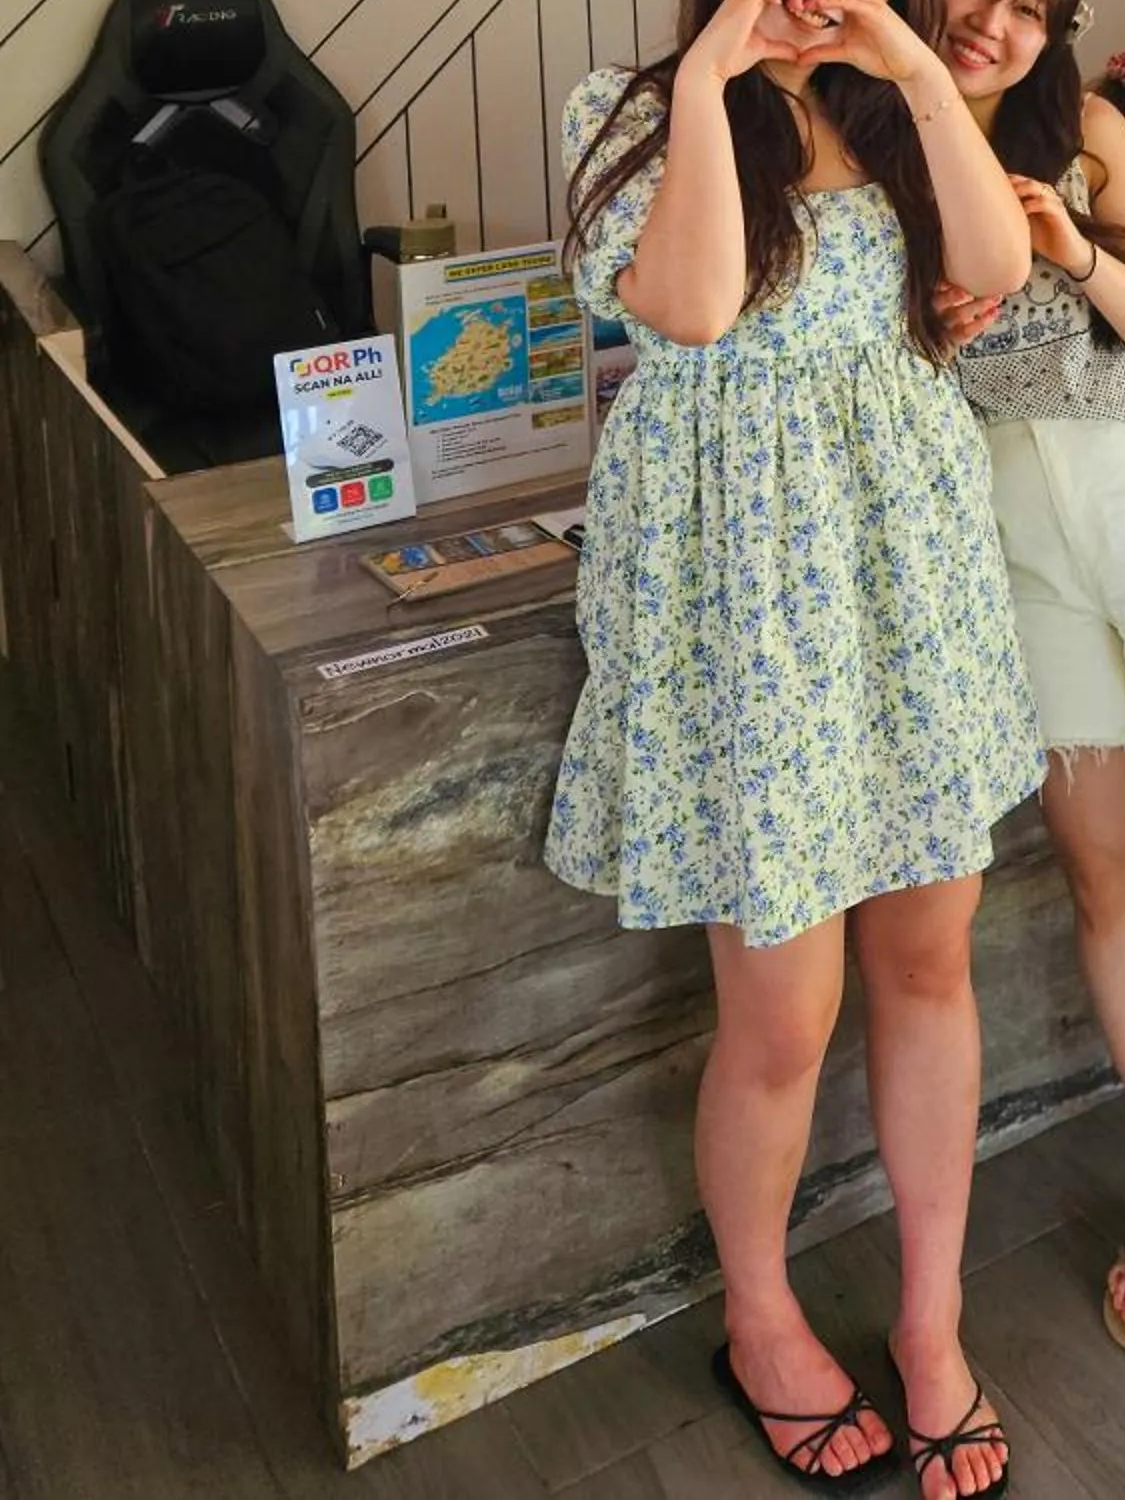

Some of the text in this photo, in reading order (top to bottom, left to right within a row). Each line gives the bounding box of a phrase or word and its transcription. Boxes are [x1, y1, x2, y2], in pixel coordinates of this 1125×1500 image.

[353, 347, 383, 367] Ph
[294, 378, 330, 395] SCAN
[333, 374, 352, 387] NA
